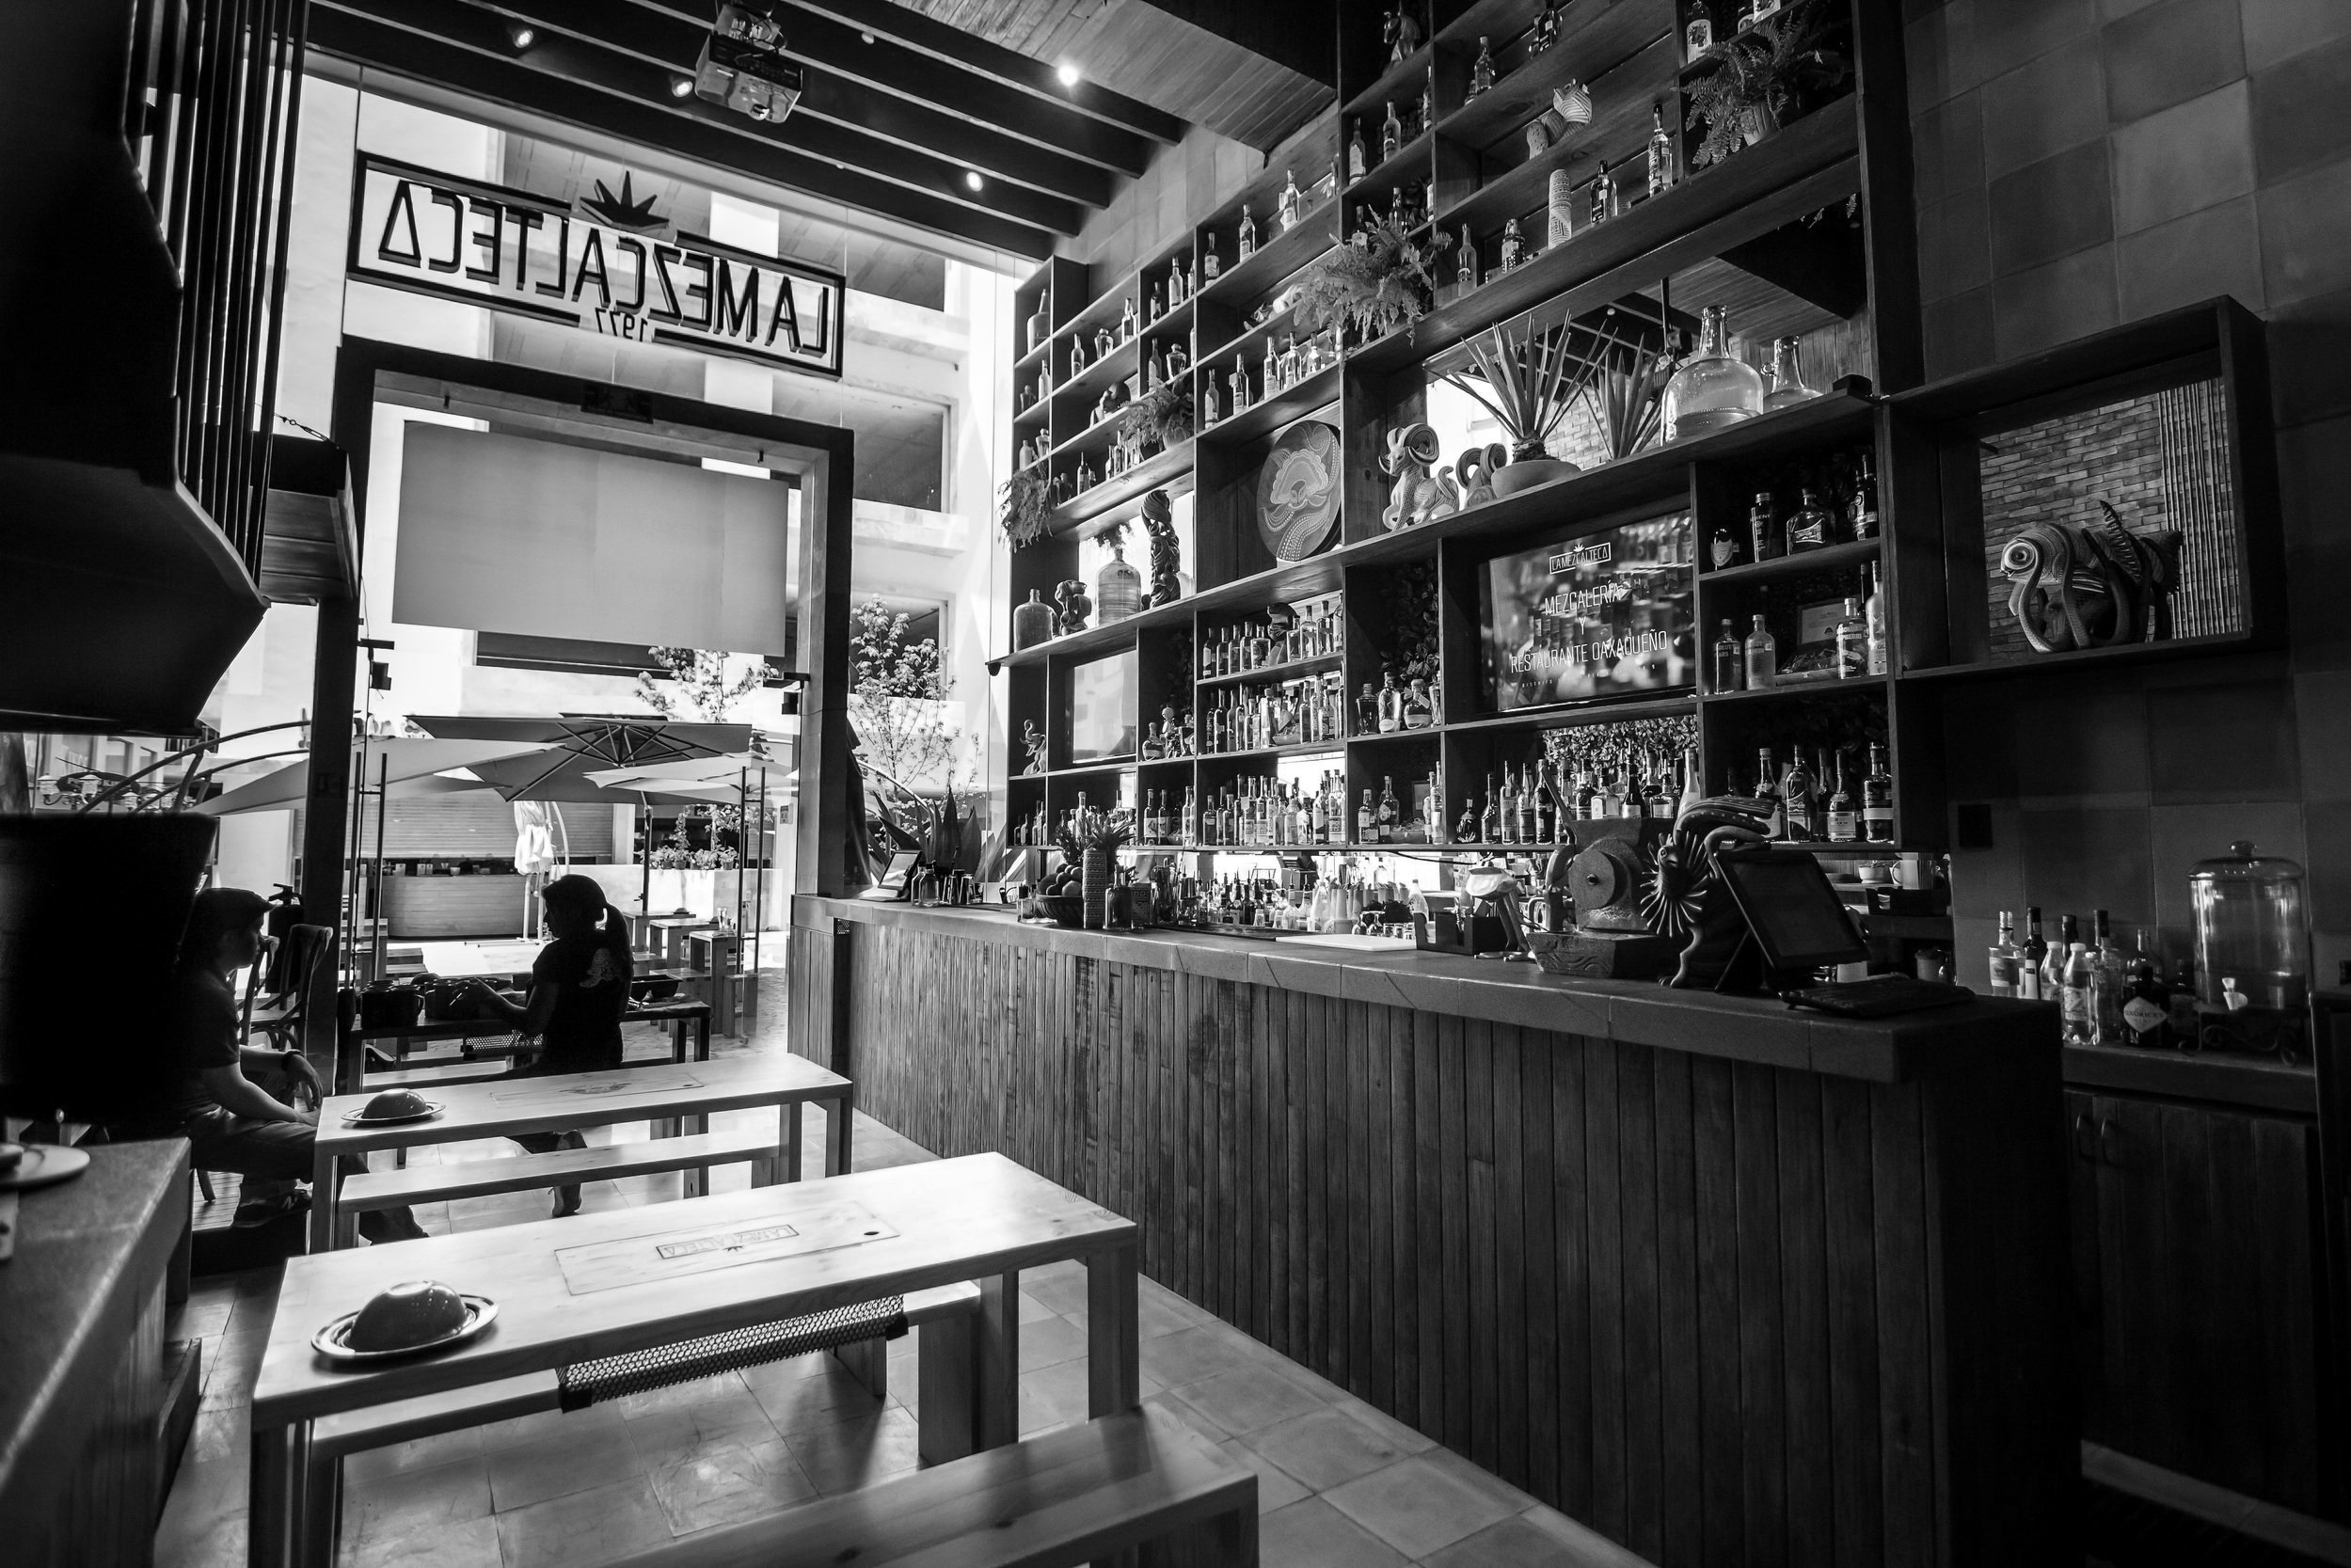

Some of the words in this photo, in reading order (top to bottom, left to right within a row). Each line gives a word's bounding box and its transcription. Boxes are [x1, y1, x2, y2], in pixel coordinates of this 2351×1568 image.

[1545, 580, 1620, 615] MEZCALERÍA
[1578, 616, 1587, 636] Y
[1511, 644, 1588, 673] RESTAURANTE
[1592, 628, 1668, 660] OAXAQUEÑO
